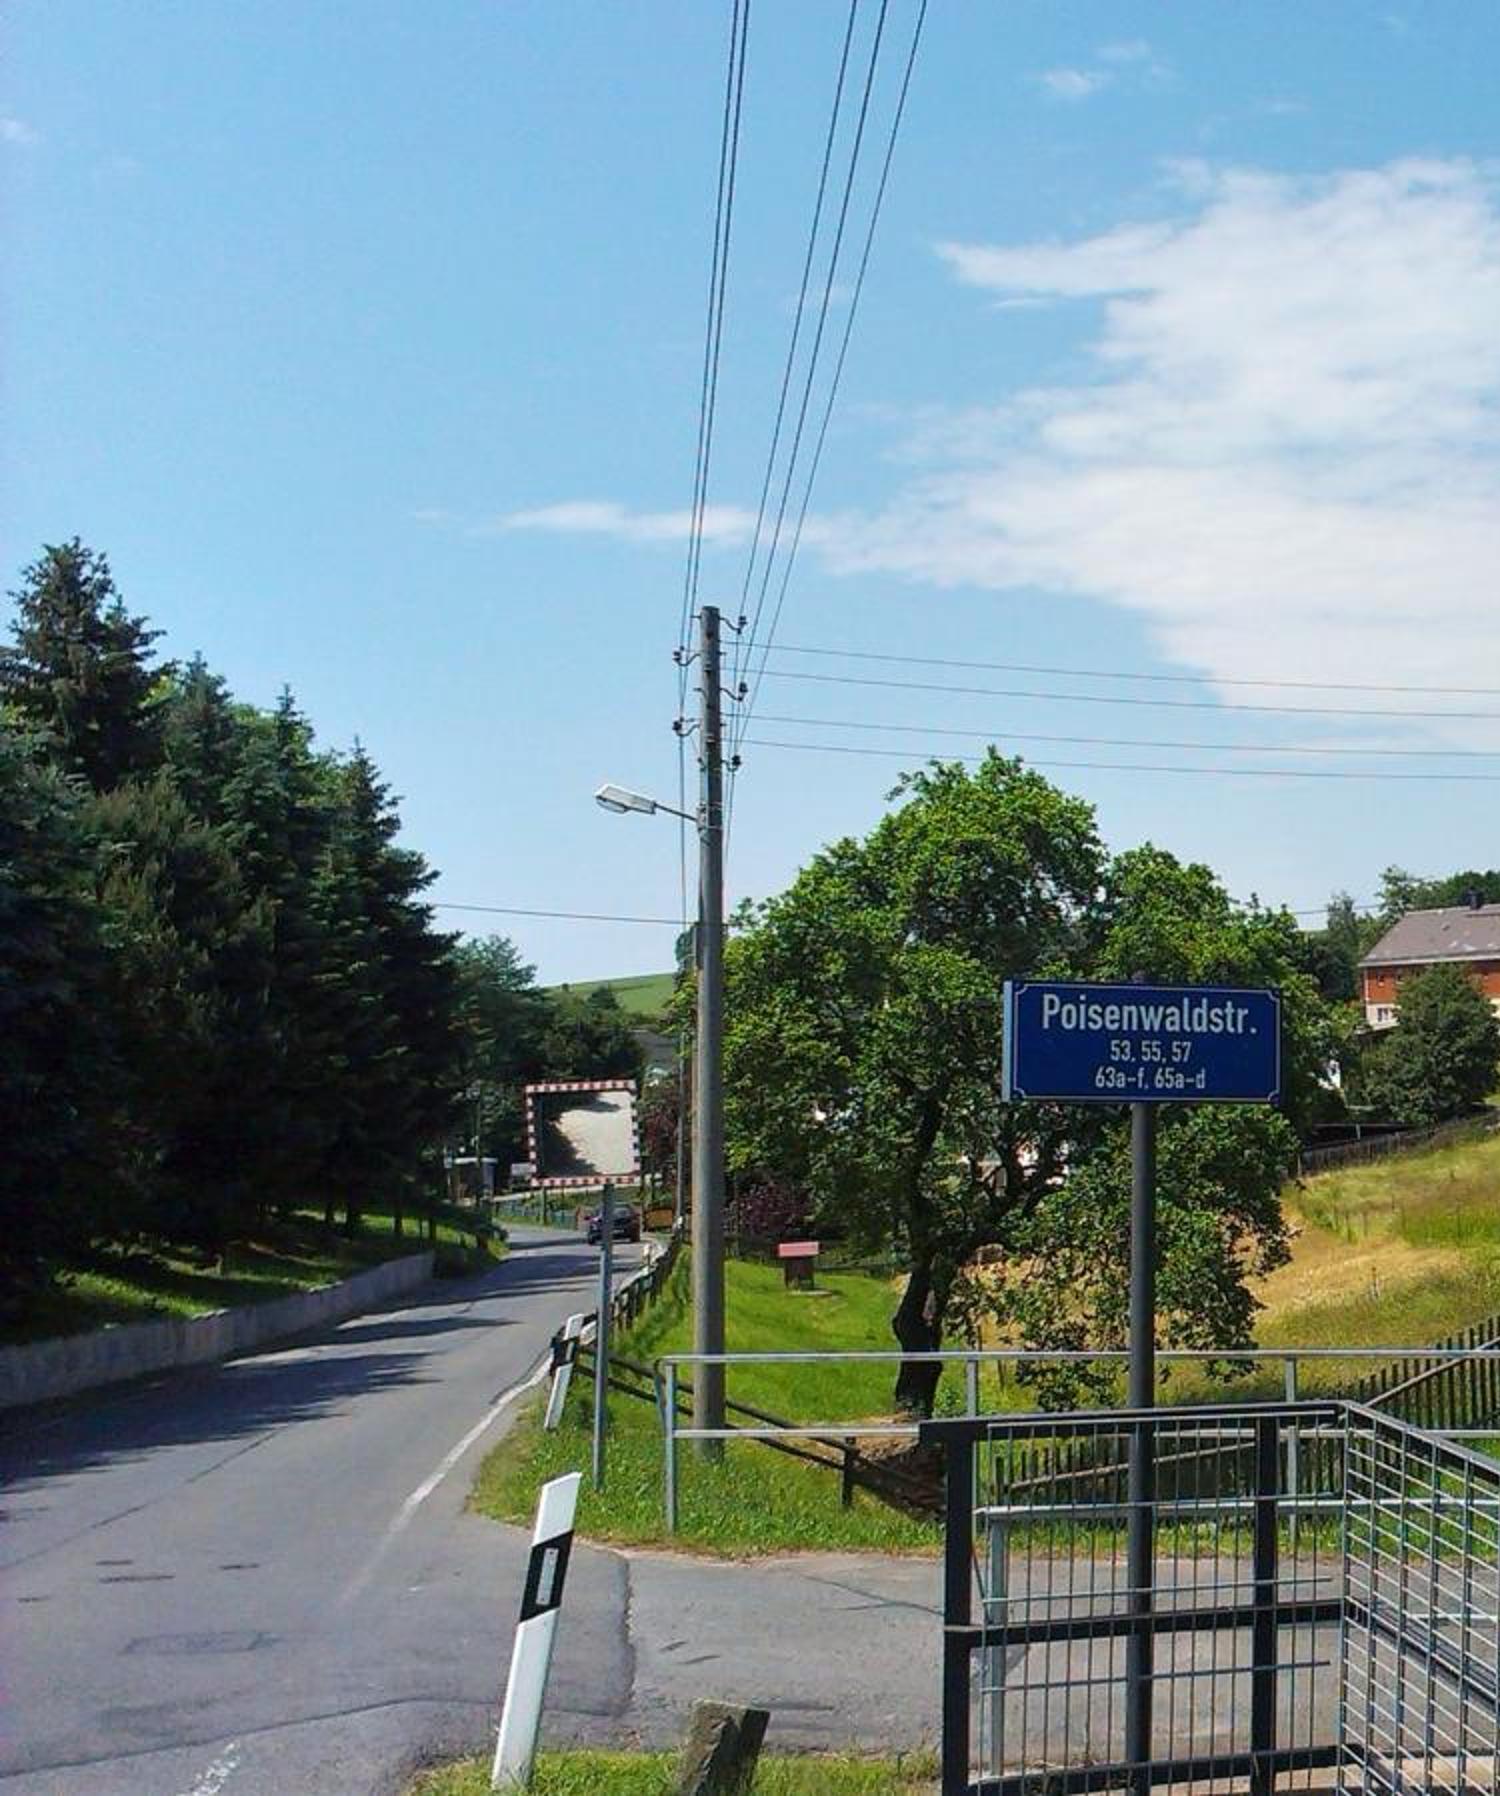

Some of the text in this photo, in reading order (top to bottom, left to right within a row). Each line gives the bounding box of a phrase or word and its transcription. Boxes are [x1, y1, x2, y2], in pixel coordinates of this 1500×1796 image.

[1042, 993, 1258, 1035] Poisenwaldstr.
[1110, 1039, 1192, 1064] 53, 55, 57
[1154, 1067, 1206, 1089] 65a-d
